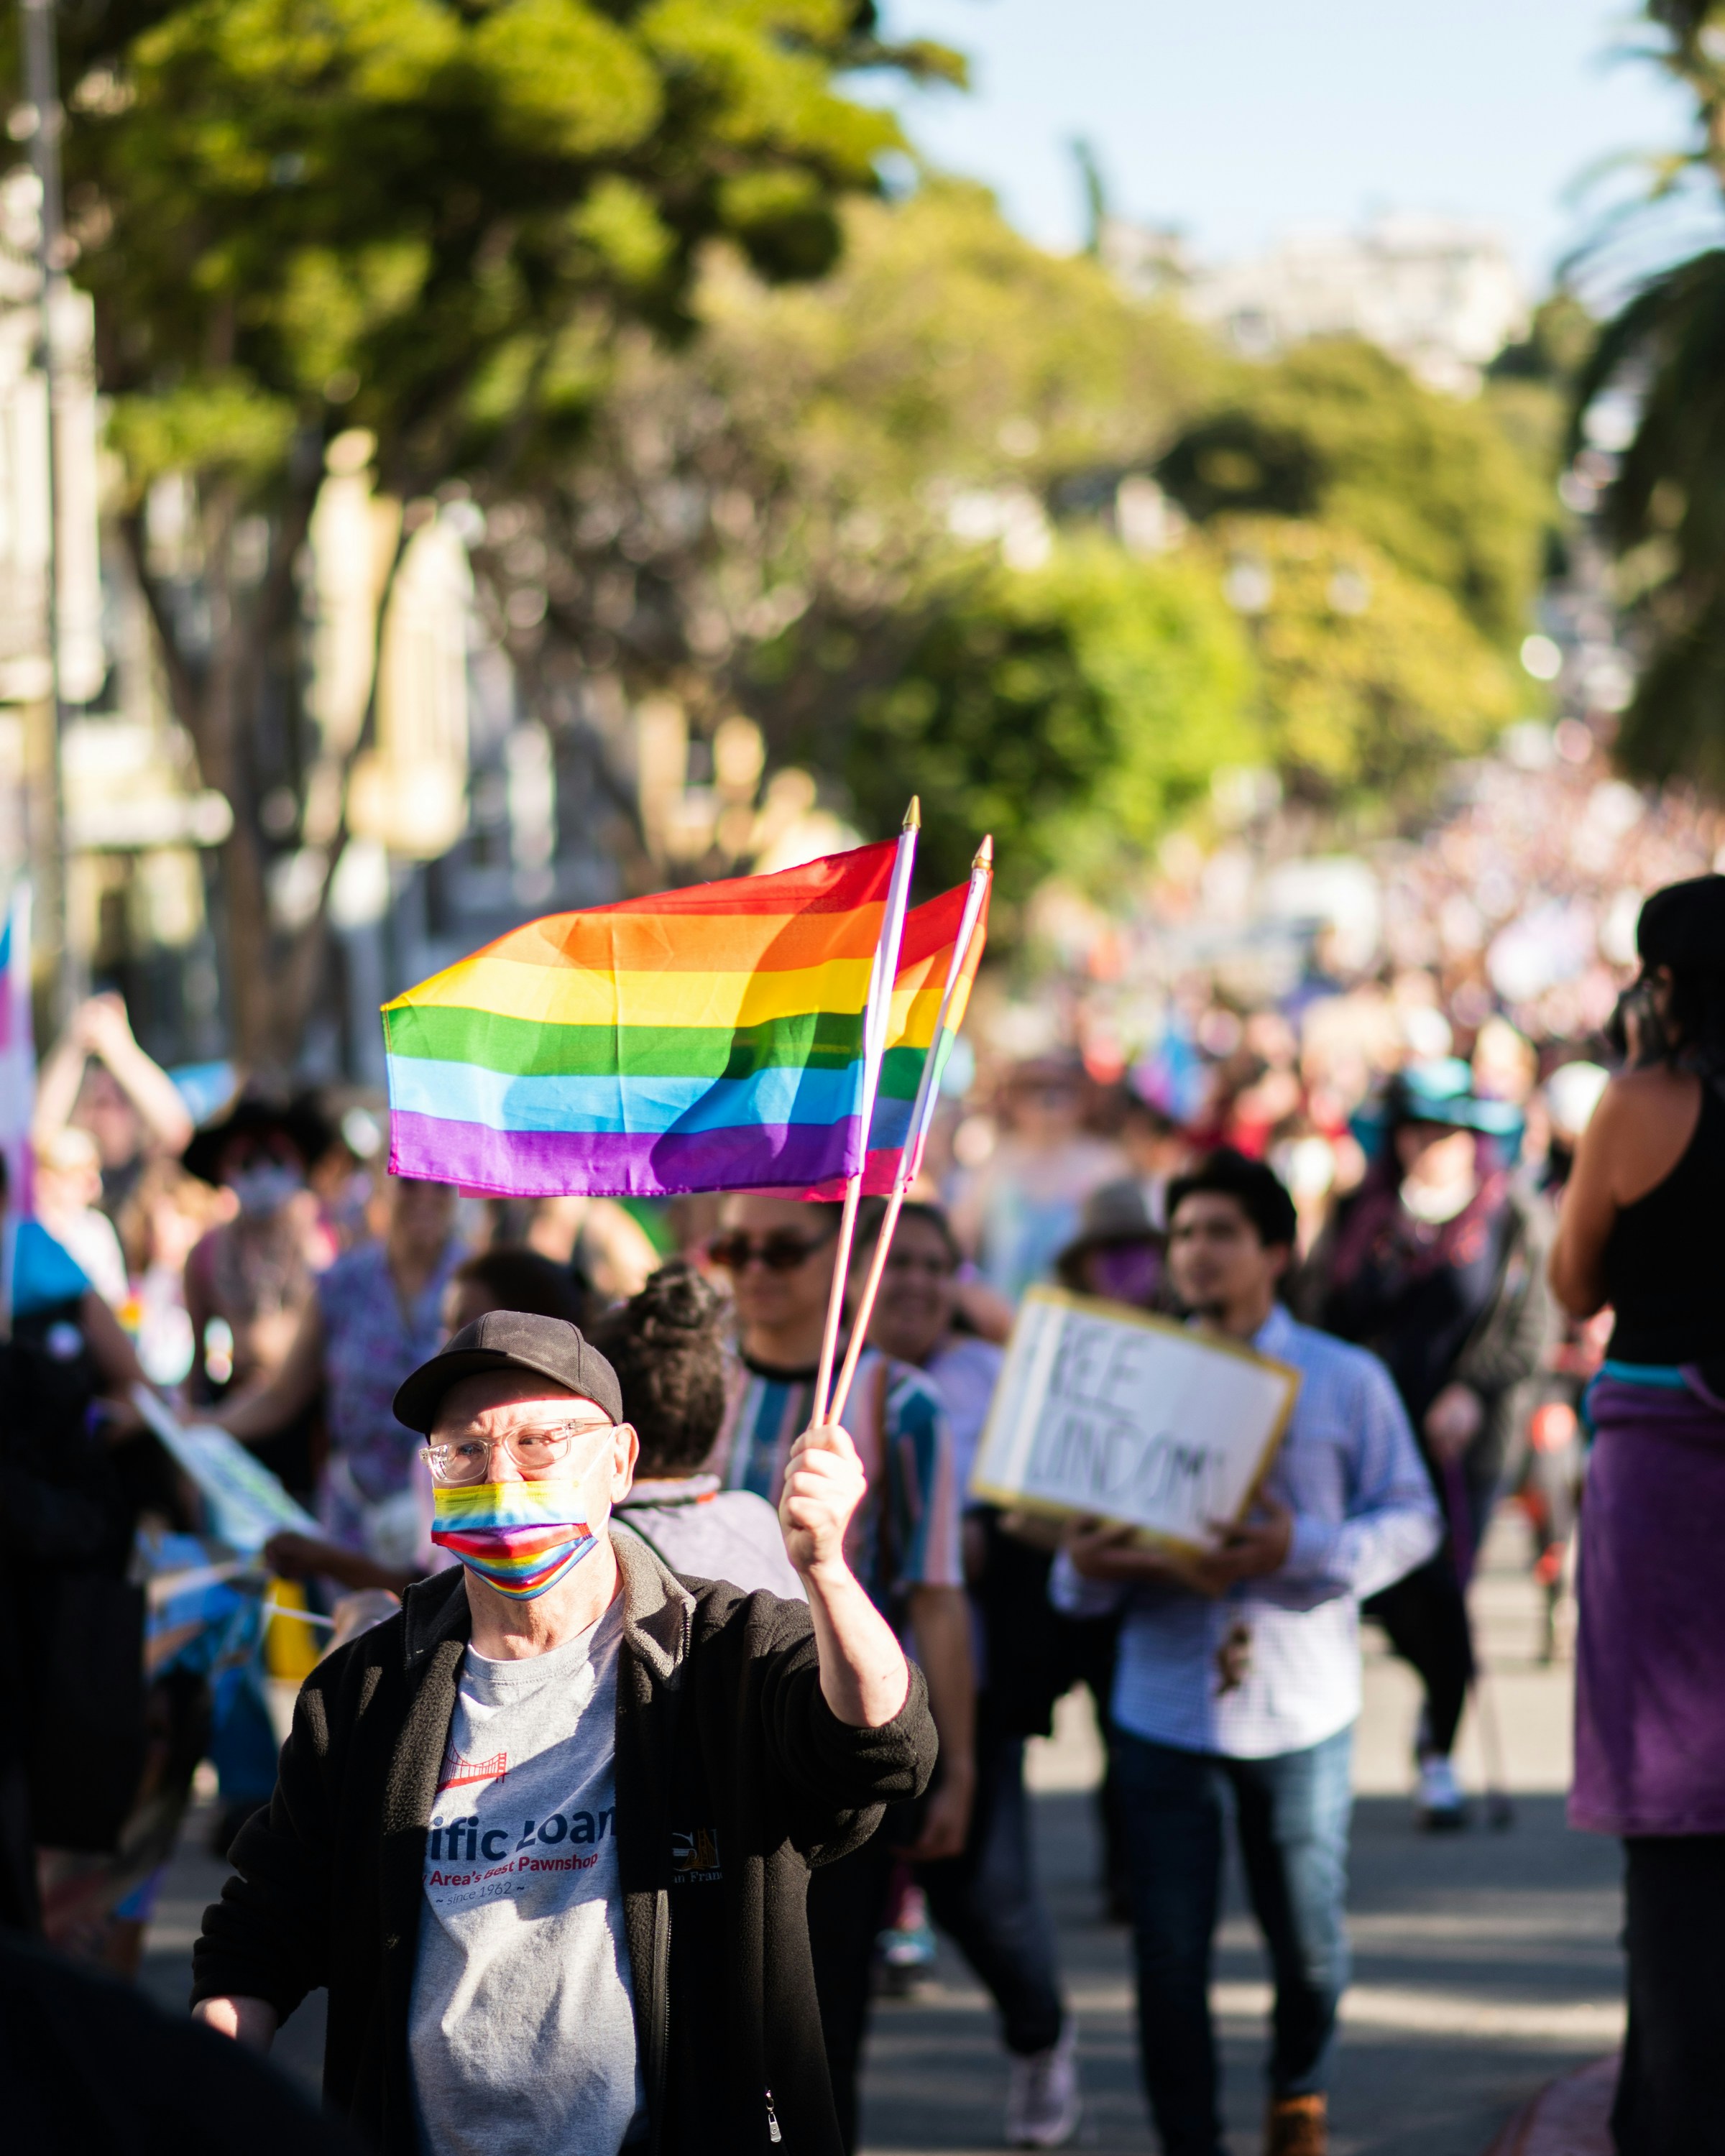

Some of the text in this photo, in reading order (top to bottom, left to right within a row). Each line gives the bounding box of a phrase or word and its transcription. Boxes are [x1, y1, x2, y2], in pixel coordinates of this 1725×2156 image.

[430, 1815, 509, 1861] ific
[518, 1853, 598, 1871] Pawnshop
[446, 1890, 477, 1905] since
[479, 1881, 512, 1898] 1962
